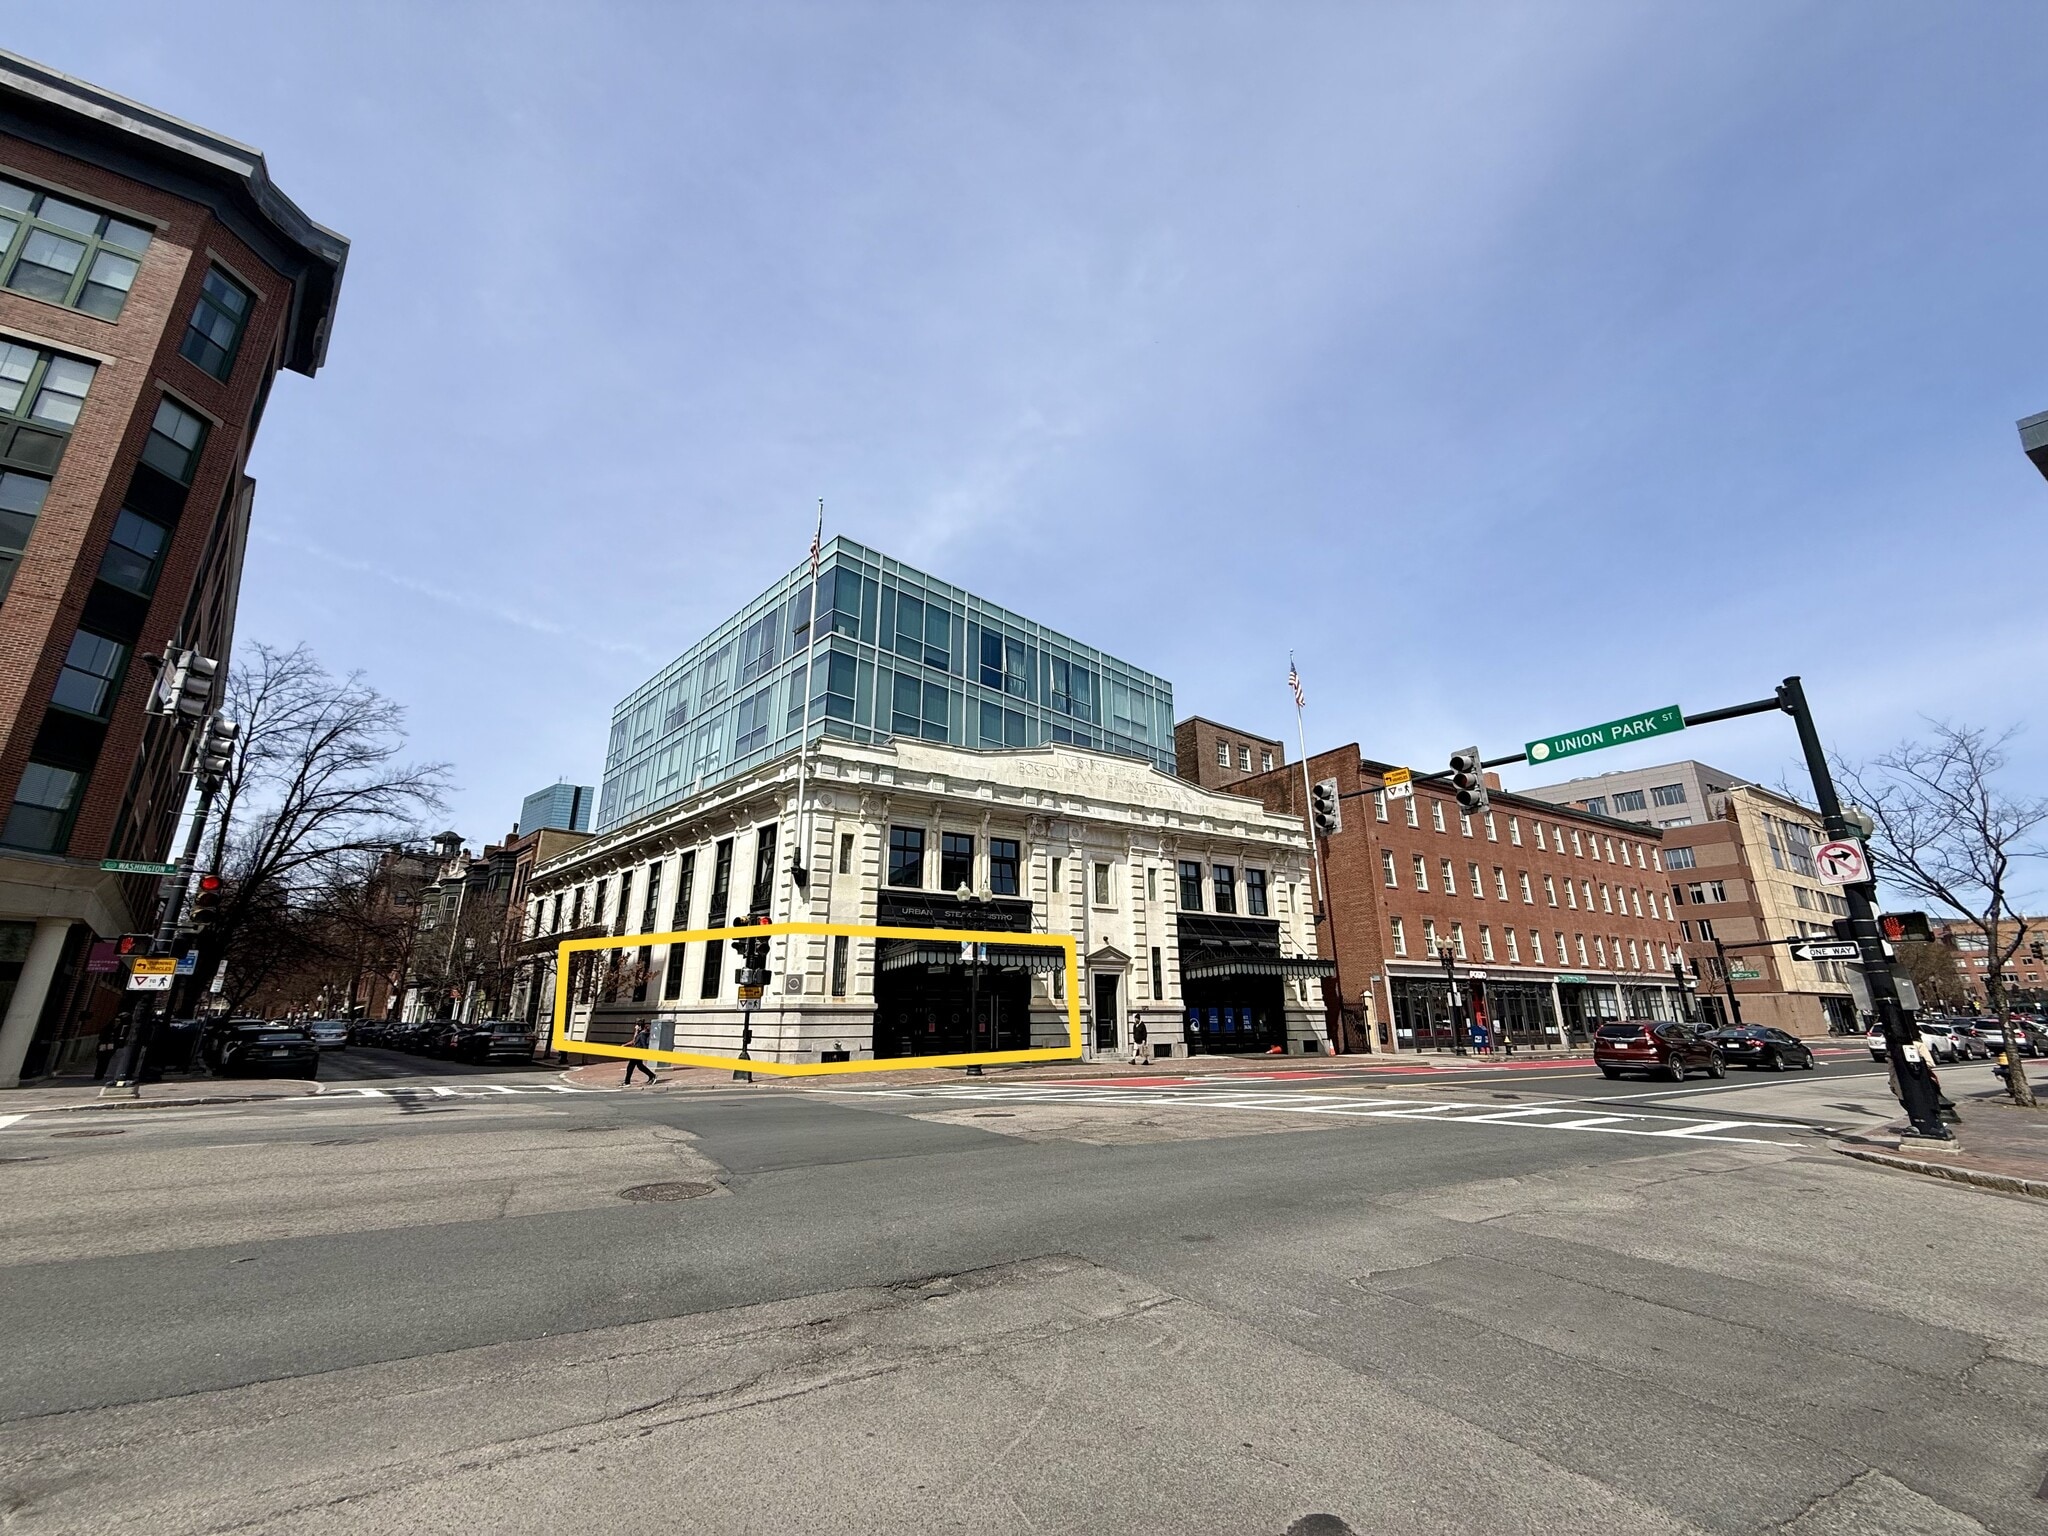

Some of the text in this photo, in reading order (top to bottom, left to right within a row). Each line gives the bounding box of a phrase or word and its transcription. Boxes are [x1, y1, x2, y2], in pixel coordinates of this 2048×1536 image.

[1554, 712, 1673, 753] UNION PARK ST
[1019, 761, 1064, 780] BOSTON
[1108, 776, 1149, 793] SAVINGS
[118, 862, 166, 873] WASHINGTON
[902, 907, 933, 916] URBAN
[984, 912, 1013, 921] ISTRO
[1809, 947, 1852, 956] ONE WAY
